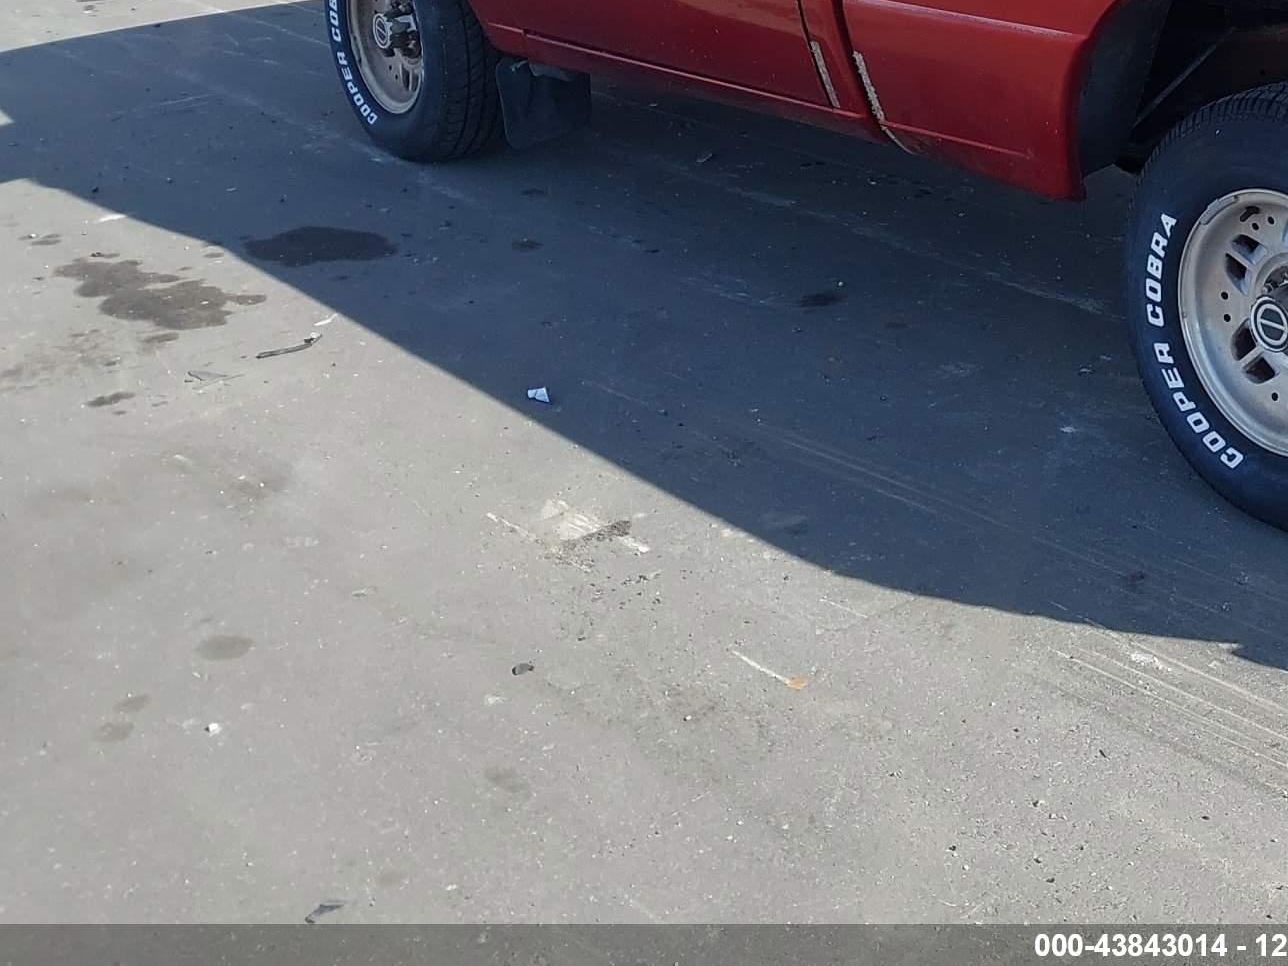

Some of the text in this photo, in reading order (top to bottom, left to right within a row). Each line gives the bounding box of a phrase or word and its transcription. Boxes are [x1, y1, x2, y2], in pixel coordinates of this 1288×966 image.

[336, 51, 378, 126] COOPER
[1145, 212, 1245, 470] COOPER COBRA
